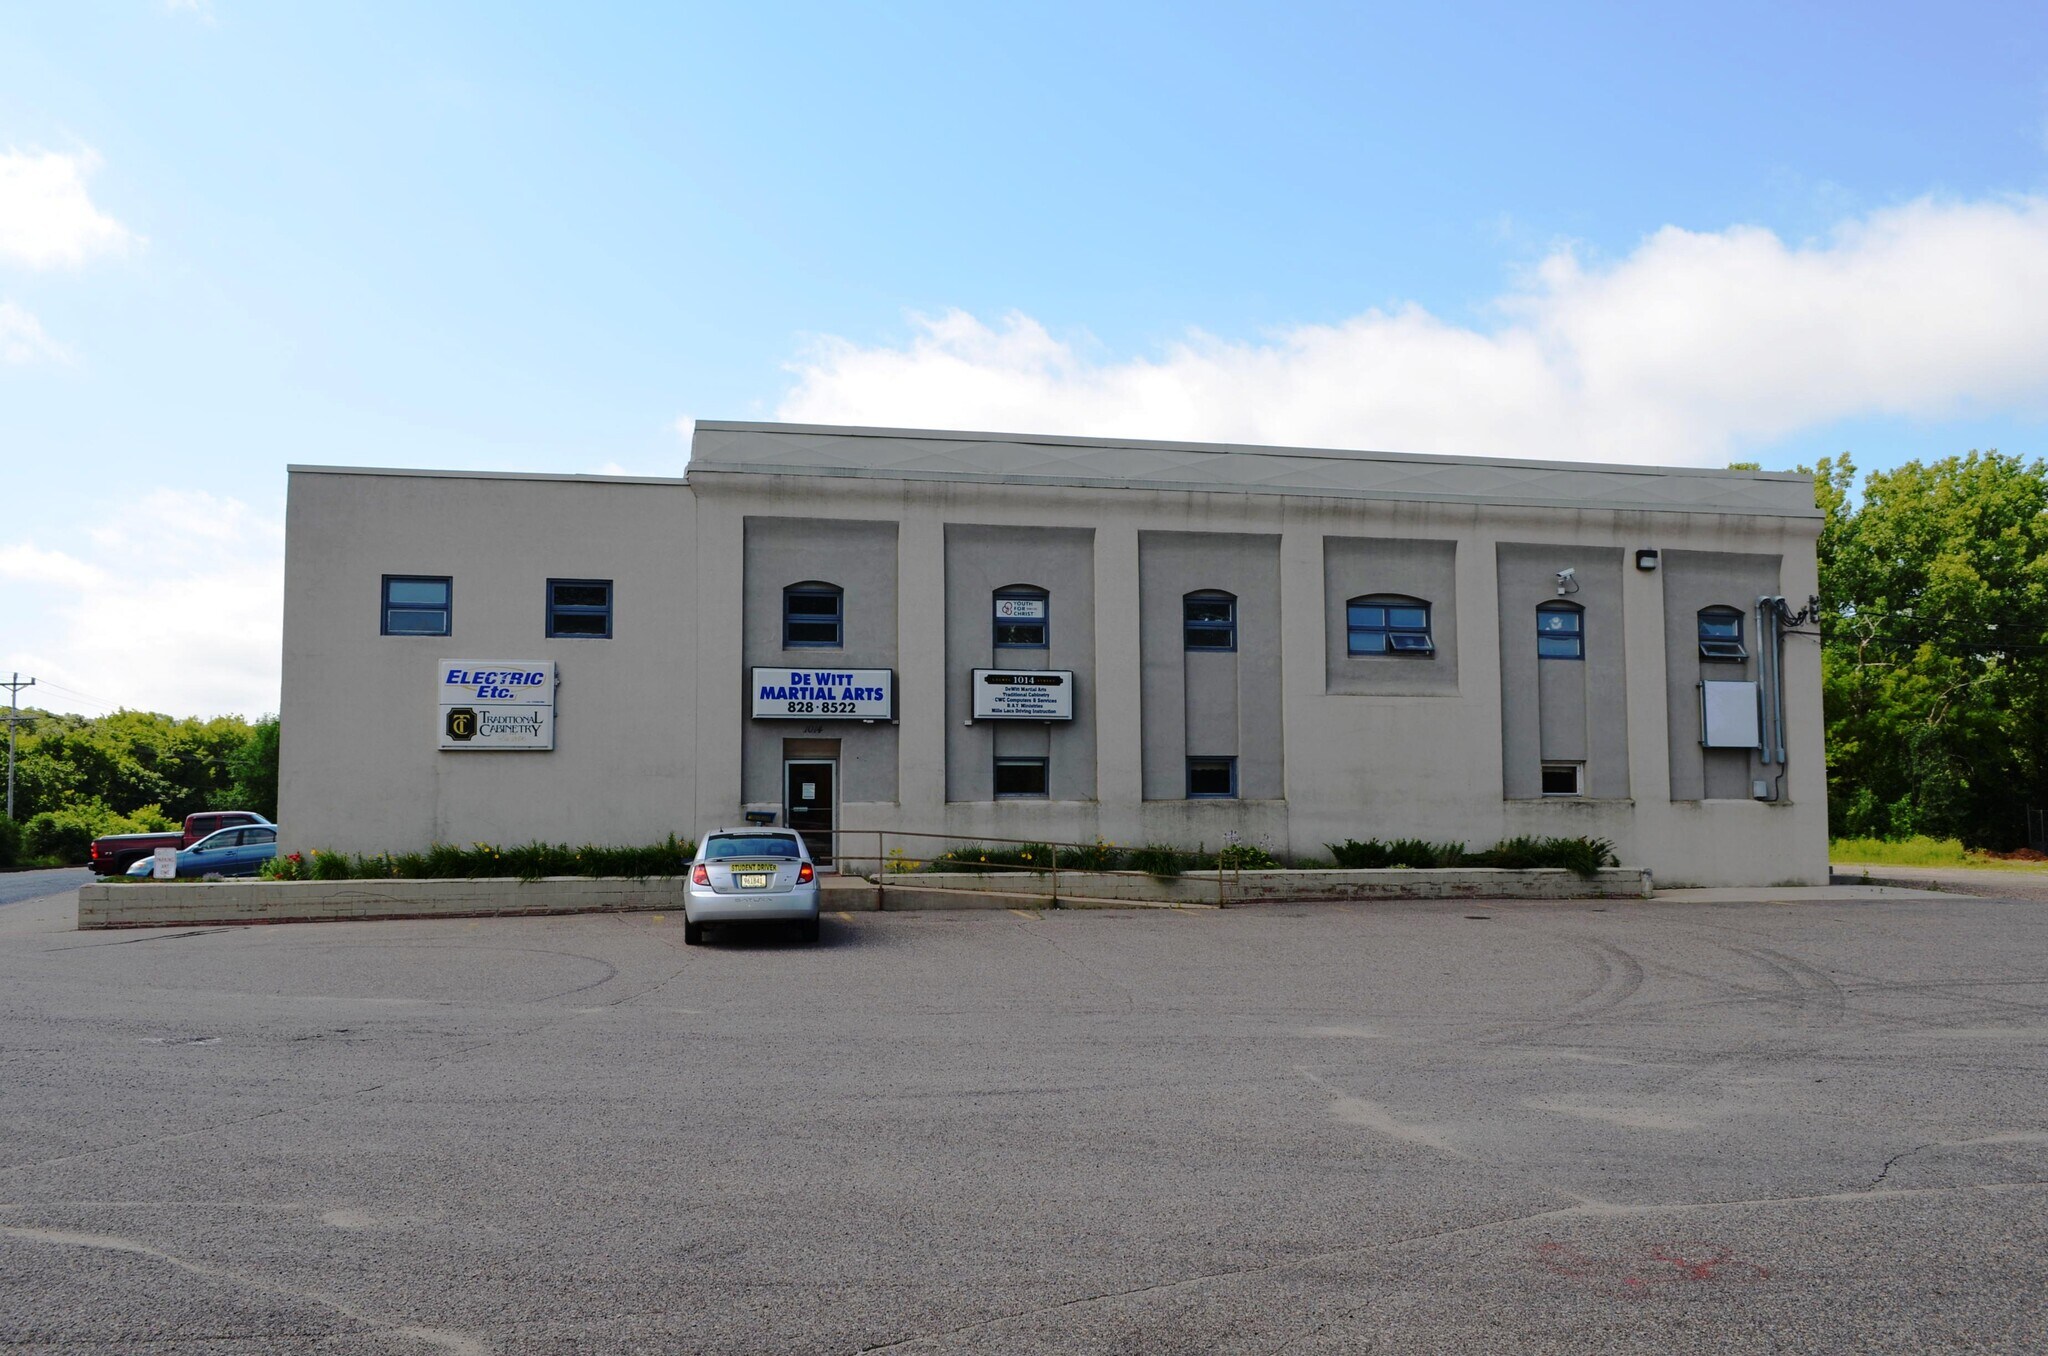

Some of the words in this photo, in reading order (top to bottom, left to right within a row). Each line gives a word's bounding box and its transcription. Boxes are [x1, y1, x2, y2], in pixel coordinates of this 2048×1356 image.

[446, 670, 544, 685] ELECTRIC
[815, 673, 853, 686] WITT
[1013, 676, 1035, 684] 1014
[476, 686, 515, 698] Etc.
[760, 686, 836, 700] MARTIAL
[841, 687, 884, 701] ARTS
[479, 710, 544, 724] TRADITIONAL
[479, 724, 542, 737] CABINETRY
[804, 724, 824, 733] 1014
